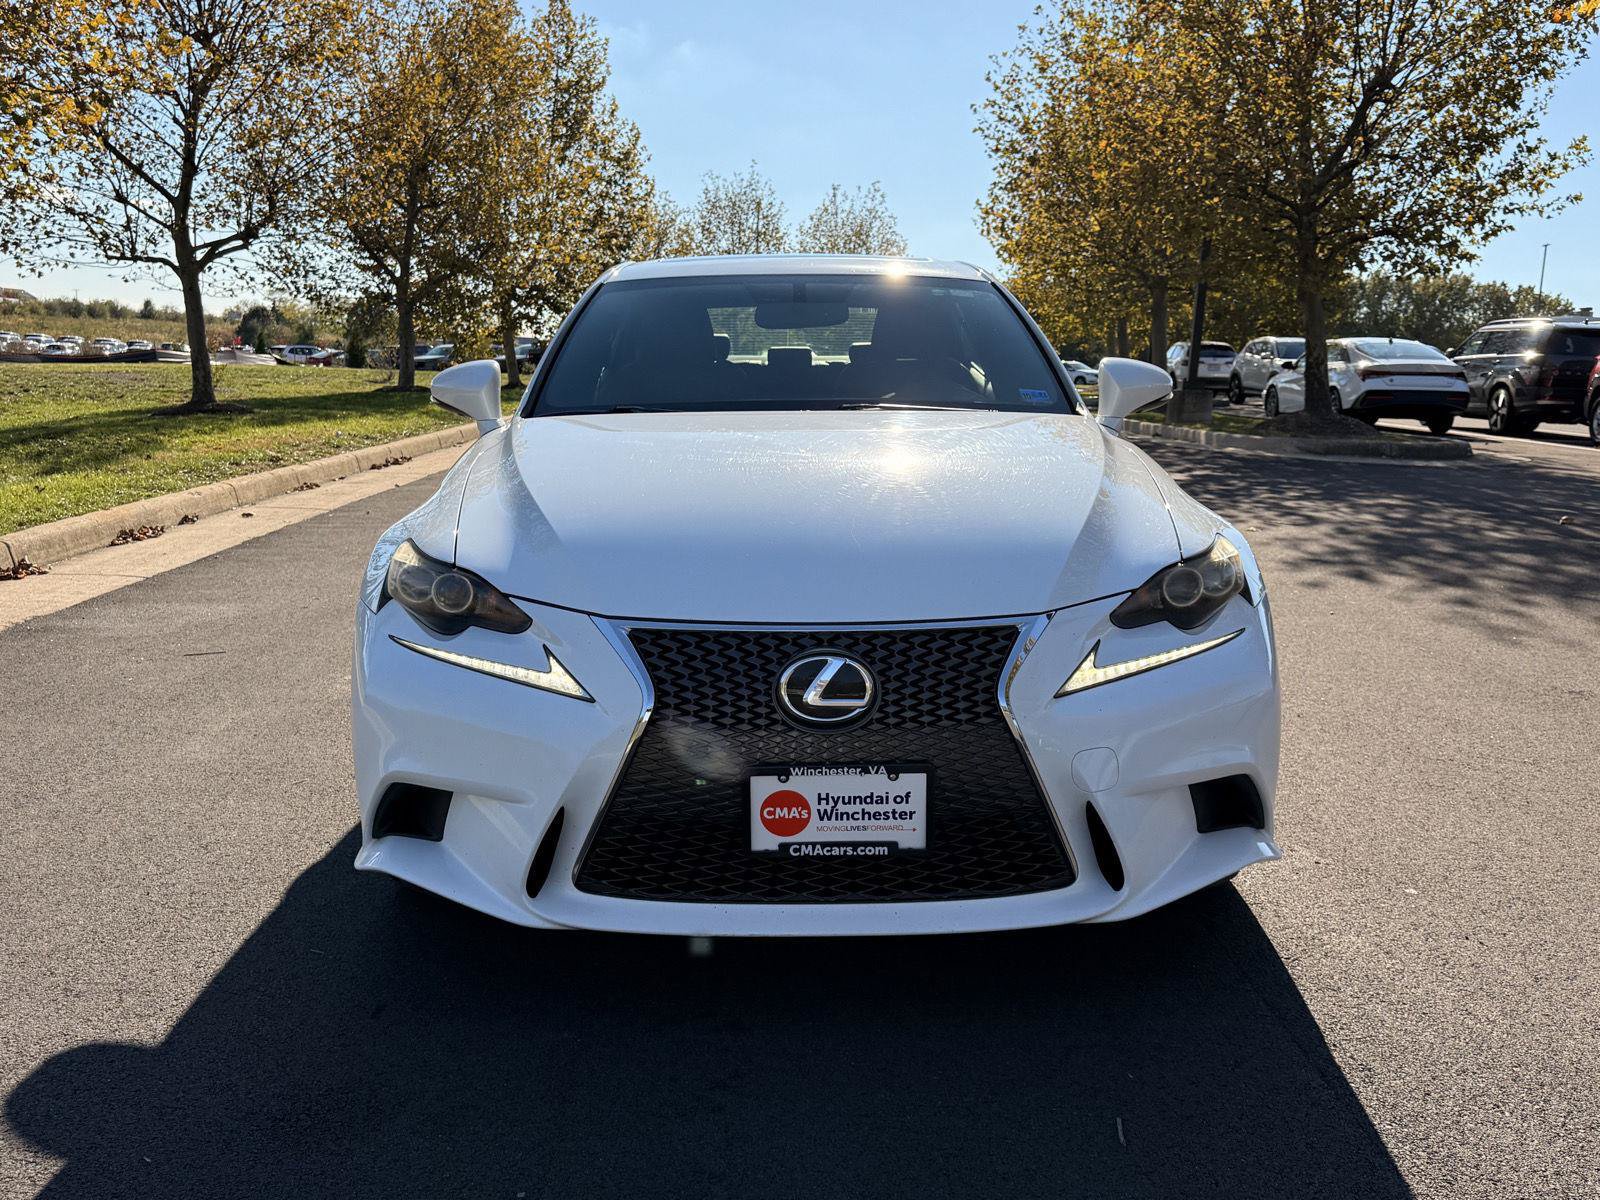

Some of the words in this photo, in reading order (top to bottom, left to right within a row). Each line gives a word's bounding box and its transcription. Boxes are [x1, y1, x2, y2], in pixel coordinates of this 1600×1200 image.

[790, 766, 866, 777] Winchester,
[868, 765, 888, 775] VA
[817, 792, 890, 808] Hyundai
[892, 791, 912, 805] of
[763, 806, 809, 819] CMA's
[816, 808, 916, 821] Winchester
[789, 844, 889, 856] CMAcars.com
